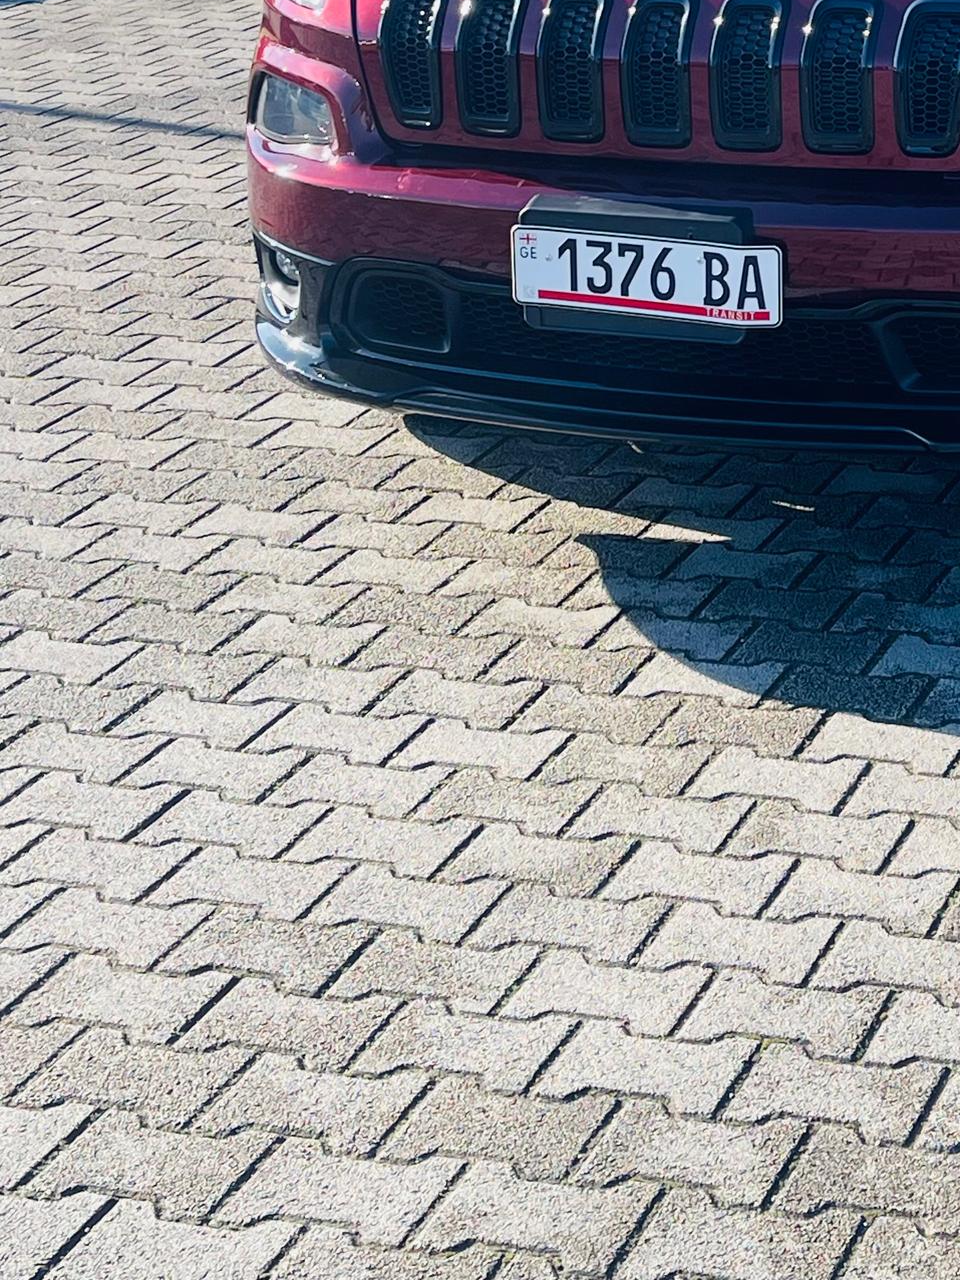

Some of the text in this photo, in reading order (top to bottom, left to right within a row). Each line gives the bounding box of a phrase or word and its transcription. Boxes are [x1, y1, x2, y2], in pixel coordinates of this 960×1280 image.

[519, 246, 537, 260] GE
[558, 238, 766, 310] 1376 BA
[705, 306, 756, 321] TRANSIT
